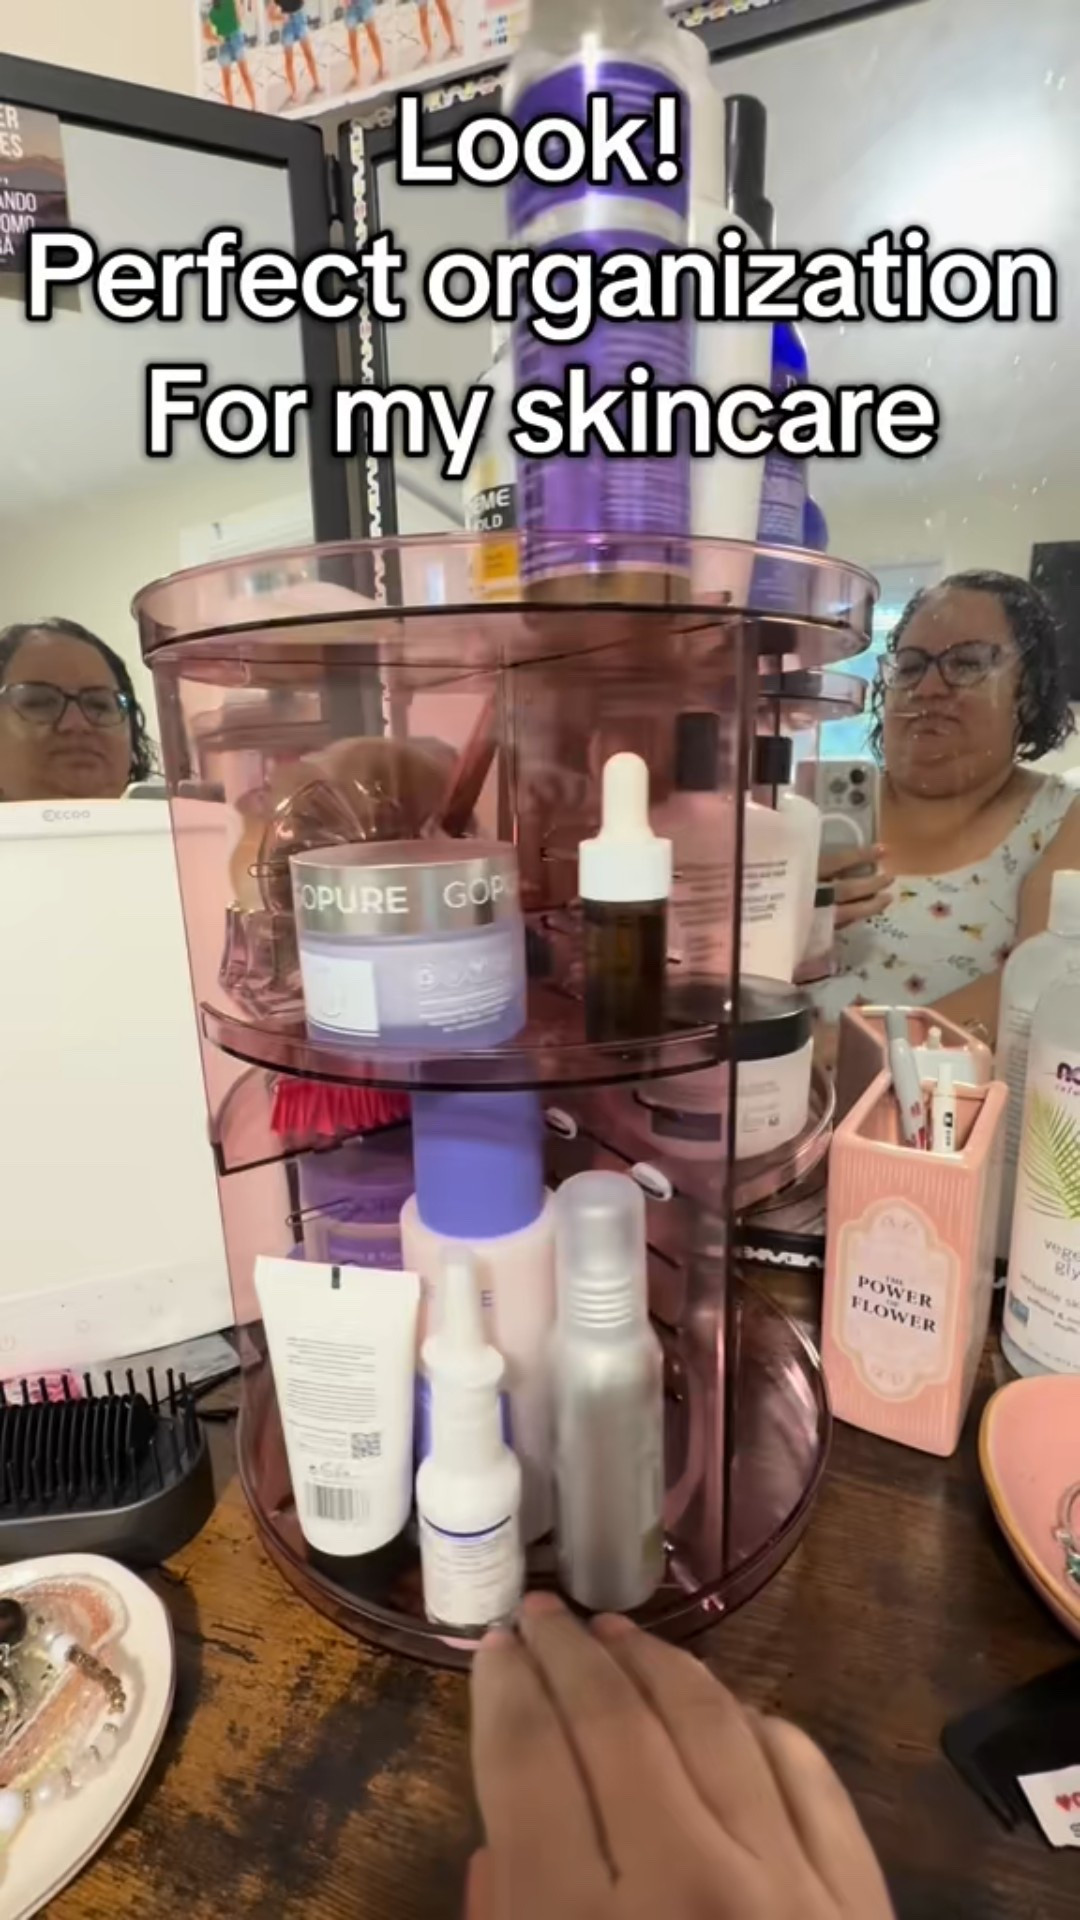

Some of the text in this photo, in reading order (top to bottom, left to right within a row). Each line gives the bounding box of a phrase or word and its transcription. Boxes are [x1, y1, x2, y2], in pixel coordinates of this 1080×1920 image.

[299, 874, 512, 914] OPURE GOP
[858, 1274, 932, 1309] POWER
[851, 1295, 937, 1334] FLOWER
